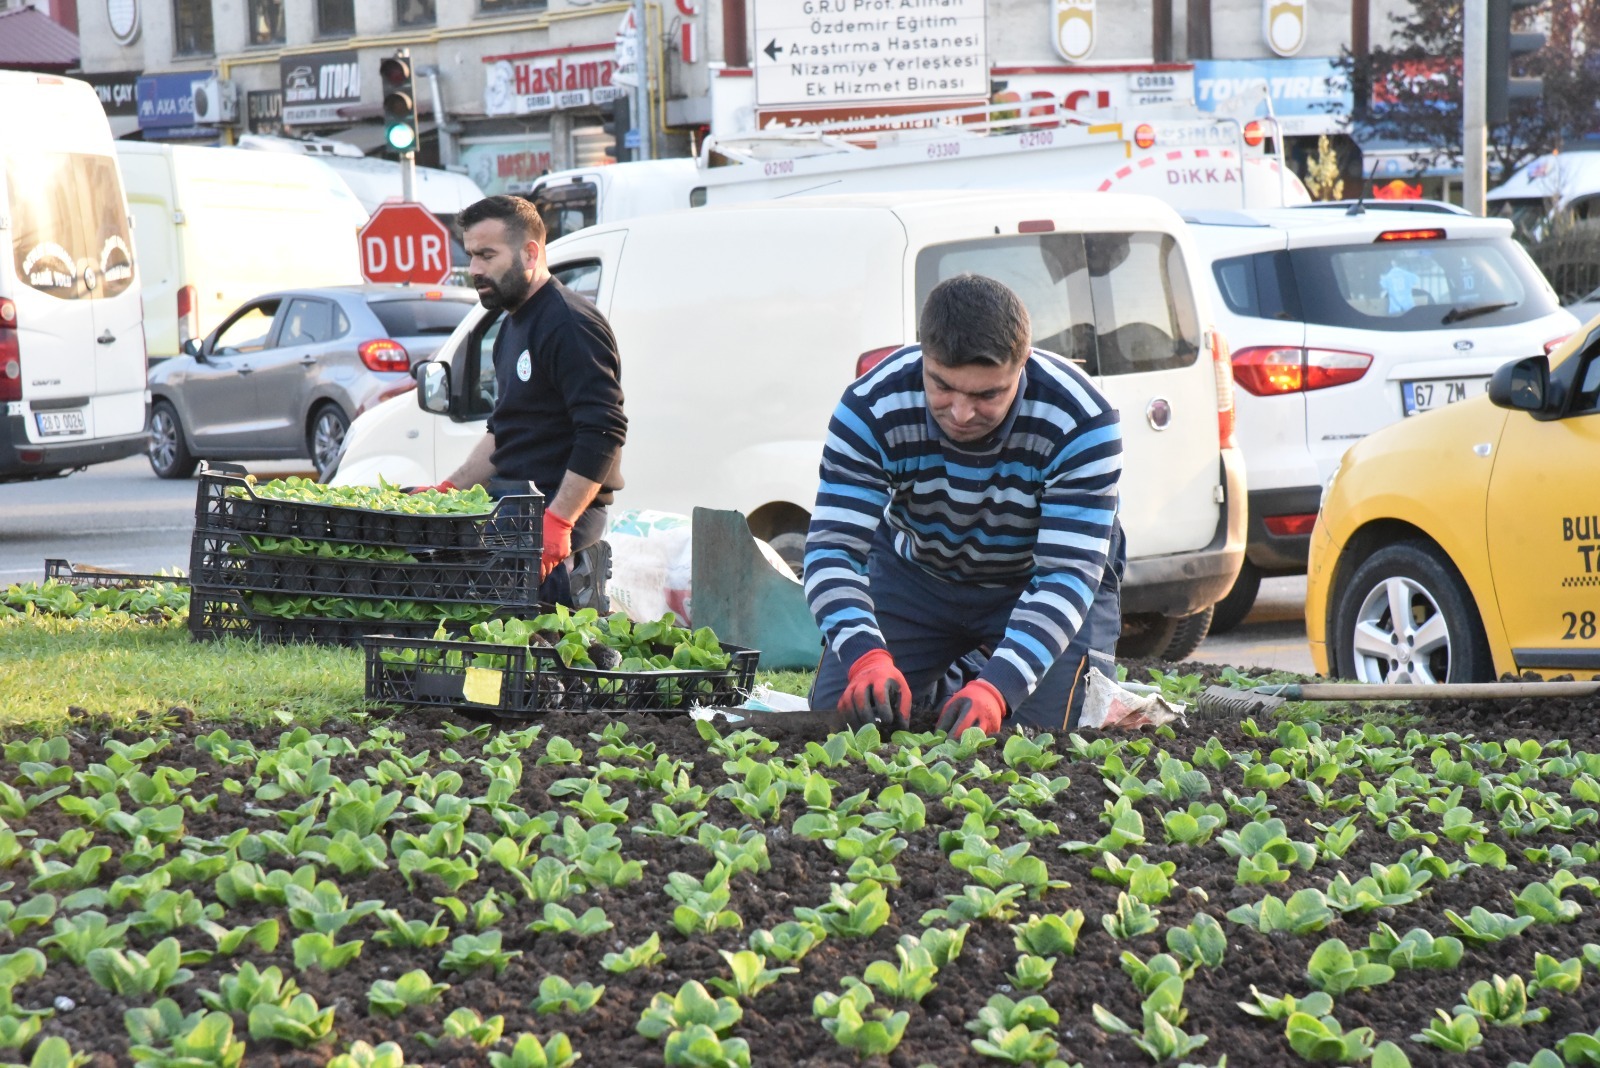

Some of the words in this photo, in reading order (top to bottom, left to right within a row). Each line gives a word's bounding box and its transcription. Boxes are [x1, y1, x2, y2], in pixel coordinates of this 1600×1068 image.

[811, 17, 889, 34] Özdemir
[897, 16, 957, 33] Eğitim
[790, 42, 880, 56] Araştırma
[888, 35, 979, 50] Hastanesi
[791, 62, 877, 77] Nizamiye
[884, 54, 979, 71] Yerleşkesi
[806, 82, 826, 96] Ek
[834, 80, 900, 94] Hizmet
[907, 77, 964, 91] Binası
[1198, 78, 1264, 101] TOY
[366, 235, 442, 273] DUR
[1415, 384, 1433, 407] 67
[1445, 383, 1466, 404] ZM
[43, 415, 53, 431] 28
[1563, 516, 1600, 541] BUL
[1577, 545, 1600, 573] T
[1562, 611, 1597, 640] 28
